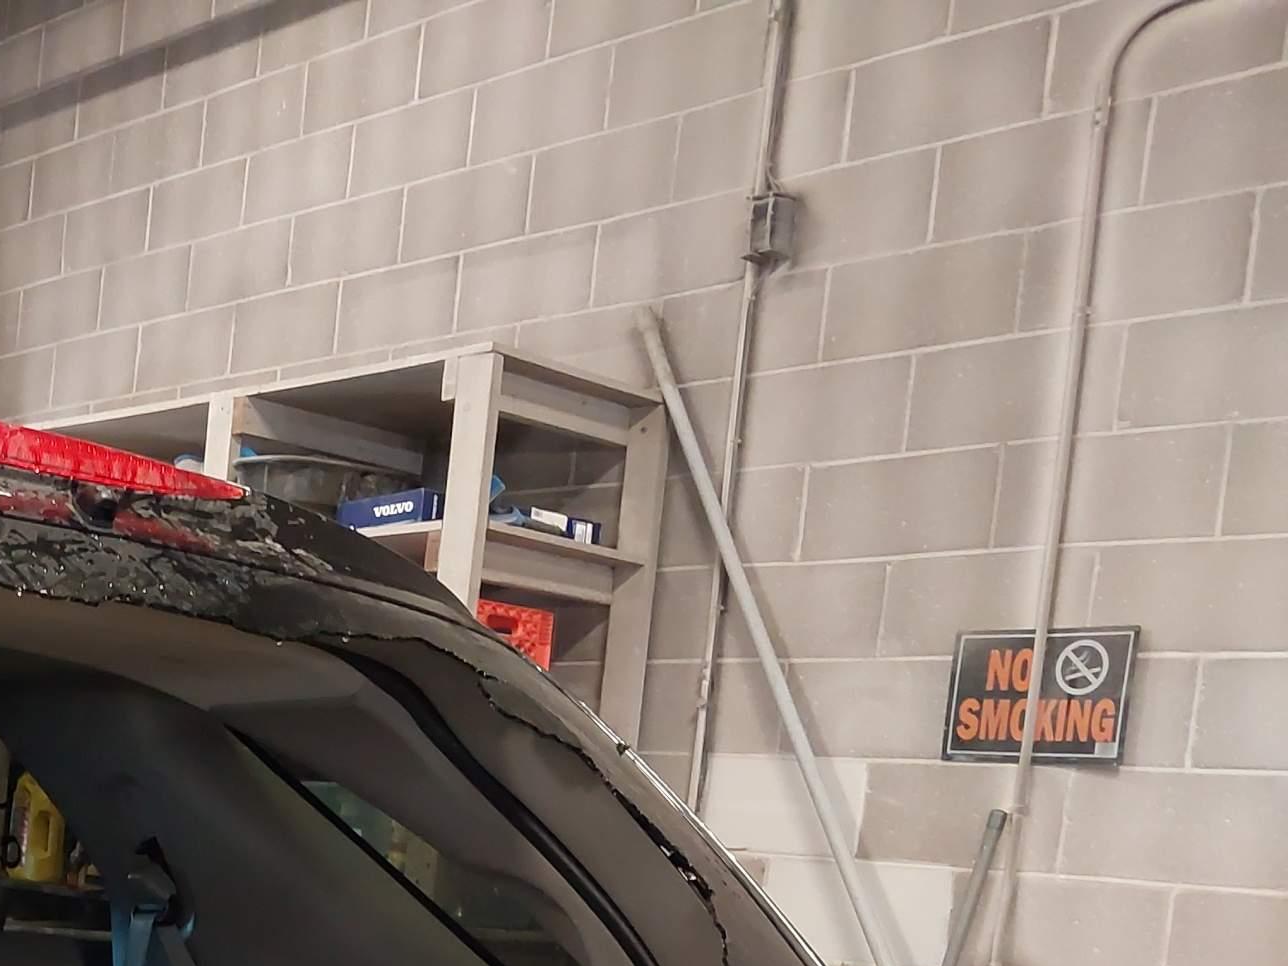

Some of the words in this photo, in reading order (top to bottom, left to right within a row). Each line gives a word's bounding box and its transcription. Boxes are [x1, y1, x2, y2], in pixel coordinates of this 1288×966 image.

[373, 500, 414, 518] VOLVO
[985, 648, 1034, 693] NO
[956, 697, 1116, 743] SMOKING
